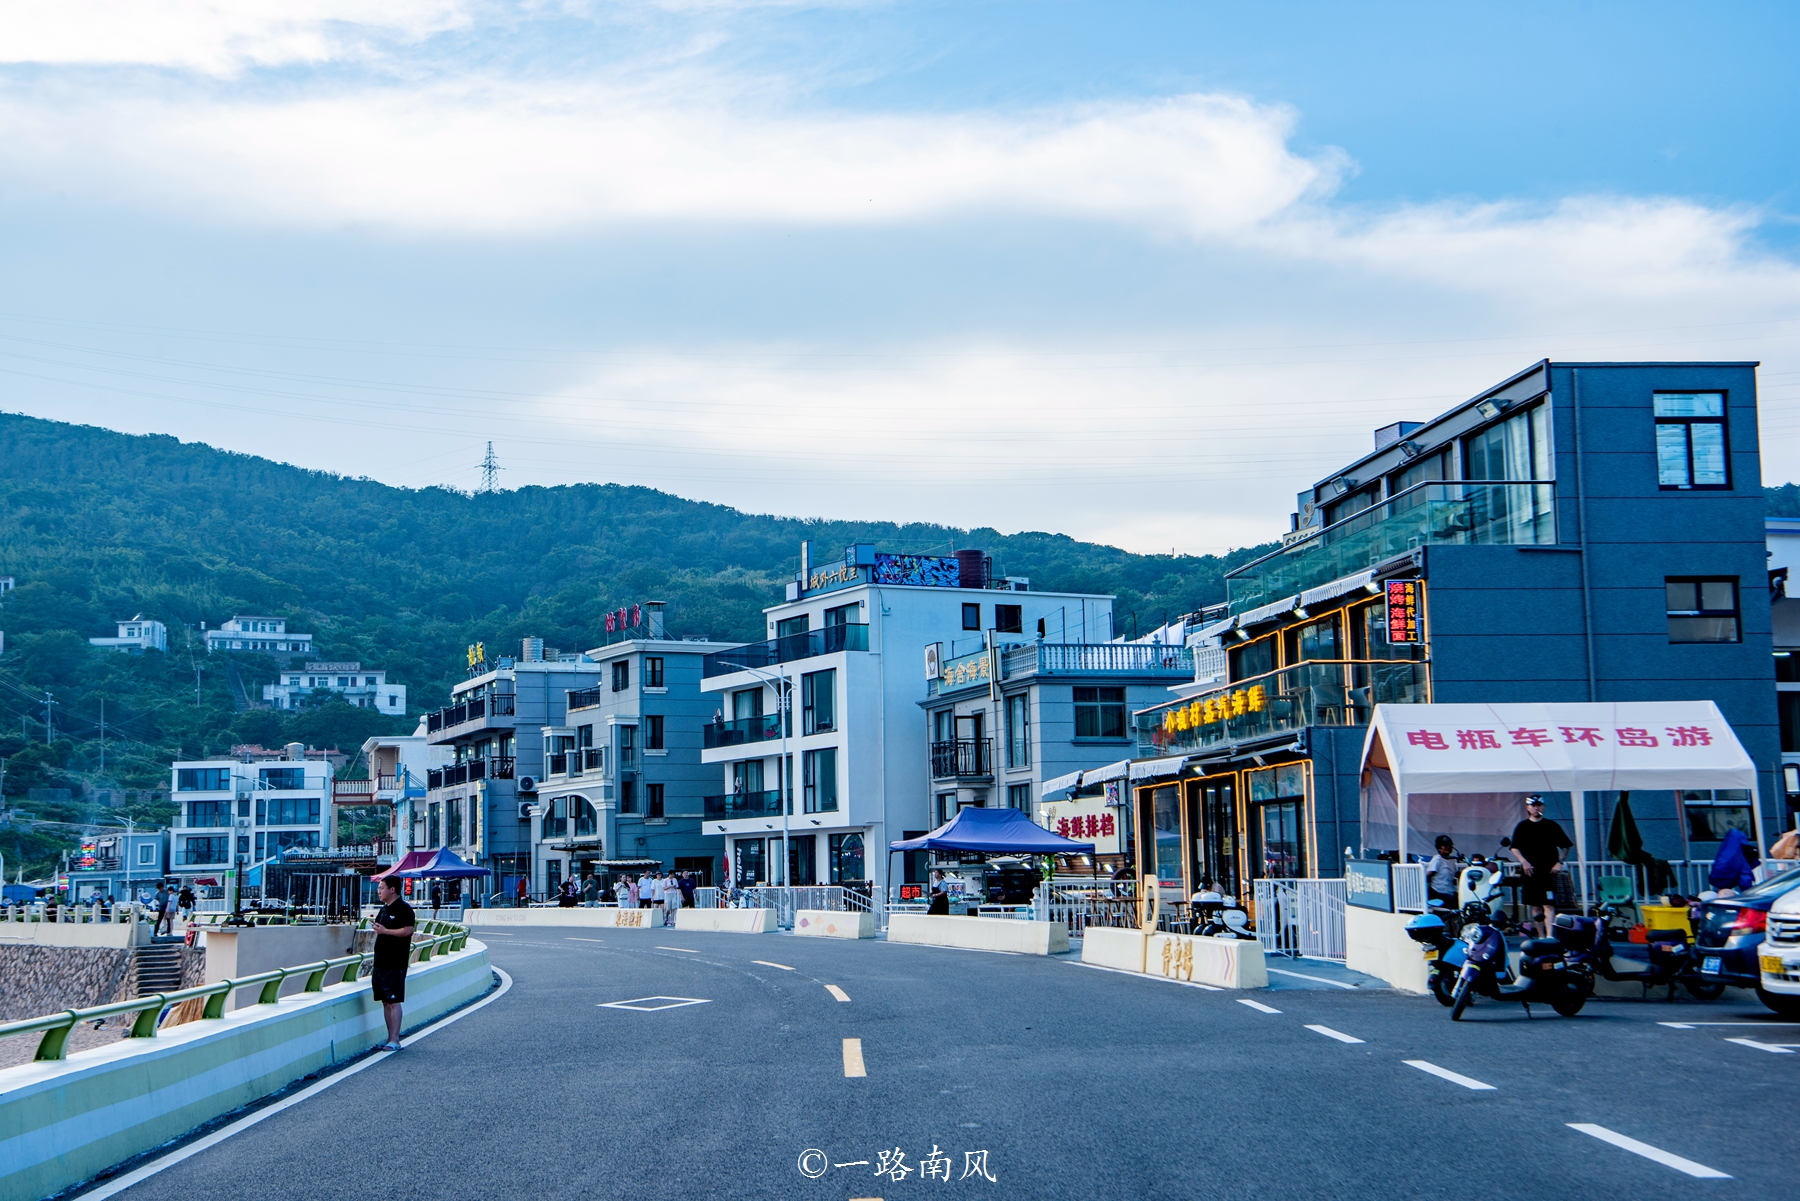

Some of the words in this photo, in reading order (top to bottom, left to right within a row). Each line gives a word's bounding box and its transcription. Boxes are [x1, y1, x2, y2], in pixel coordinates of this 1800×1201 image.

[1389, 583, 1406, 641] 烧烤海鲜面
[1405, 583, 1417, 641] 海鲜代加工
[1406, 725, 1713, 750] 电瓶车环岛游
[1056, 813, 1115, 838] 海鲜排档
[901, 886, 921, 898] 超市
